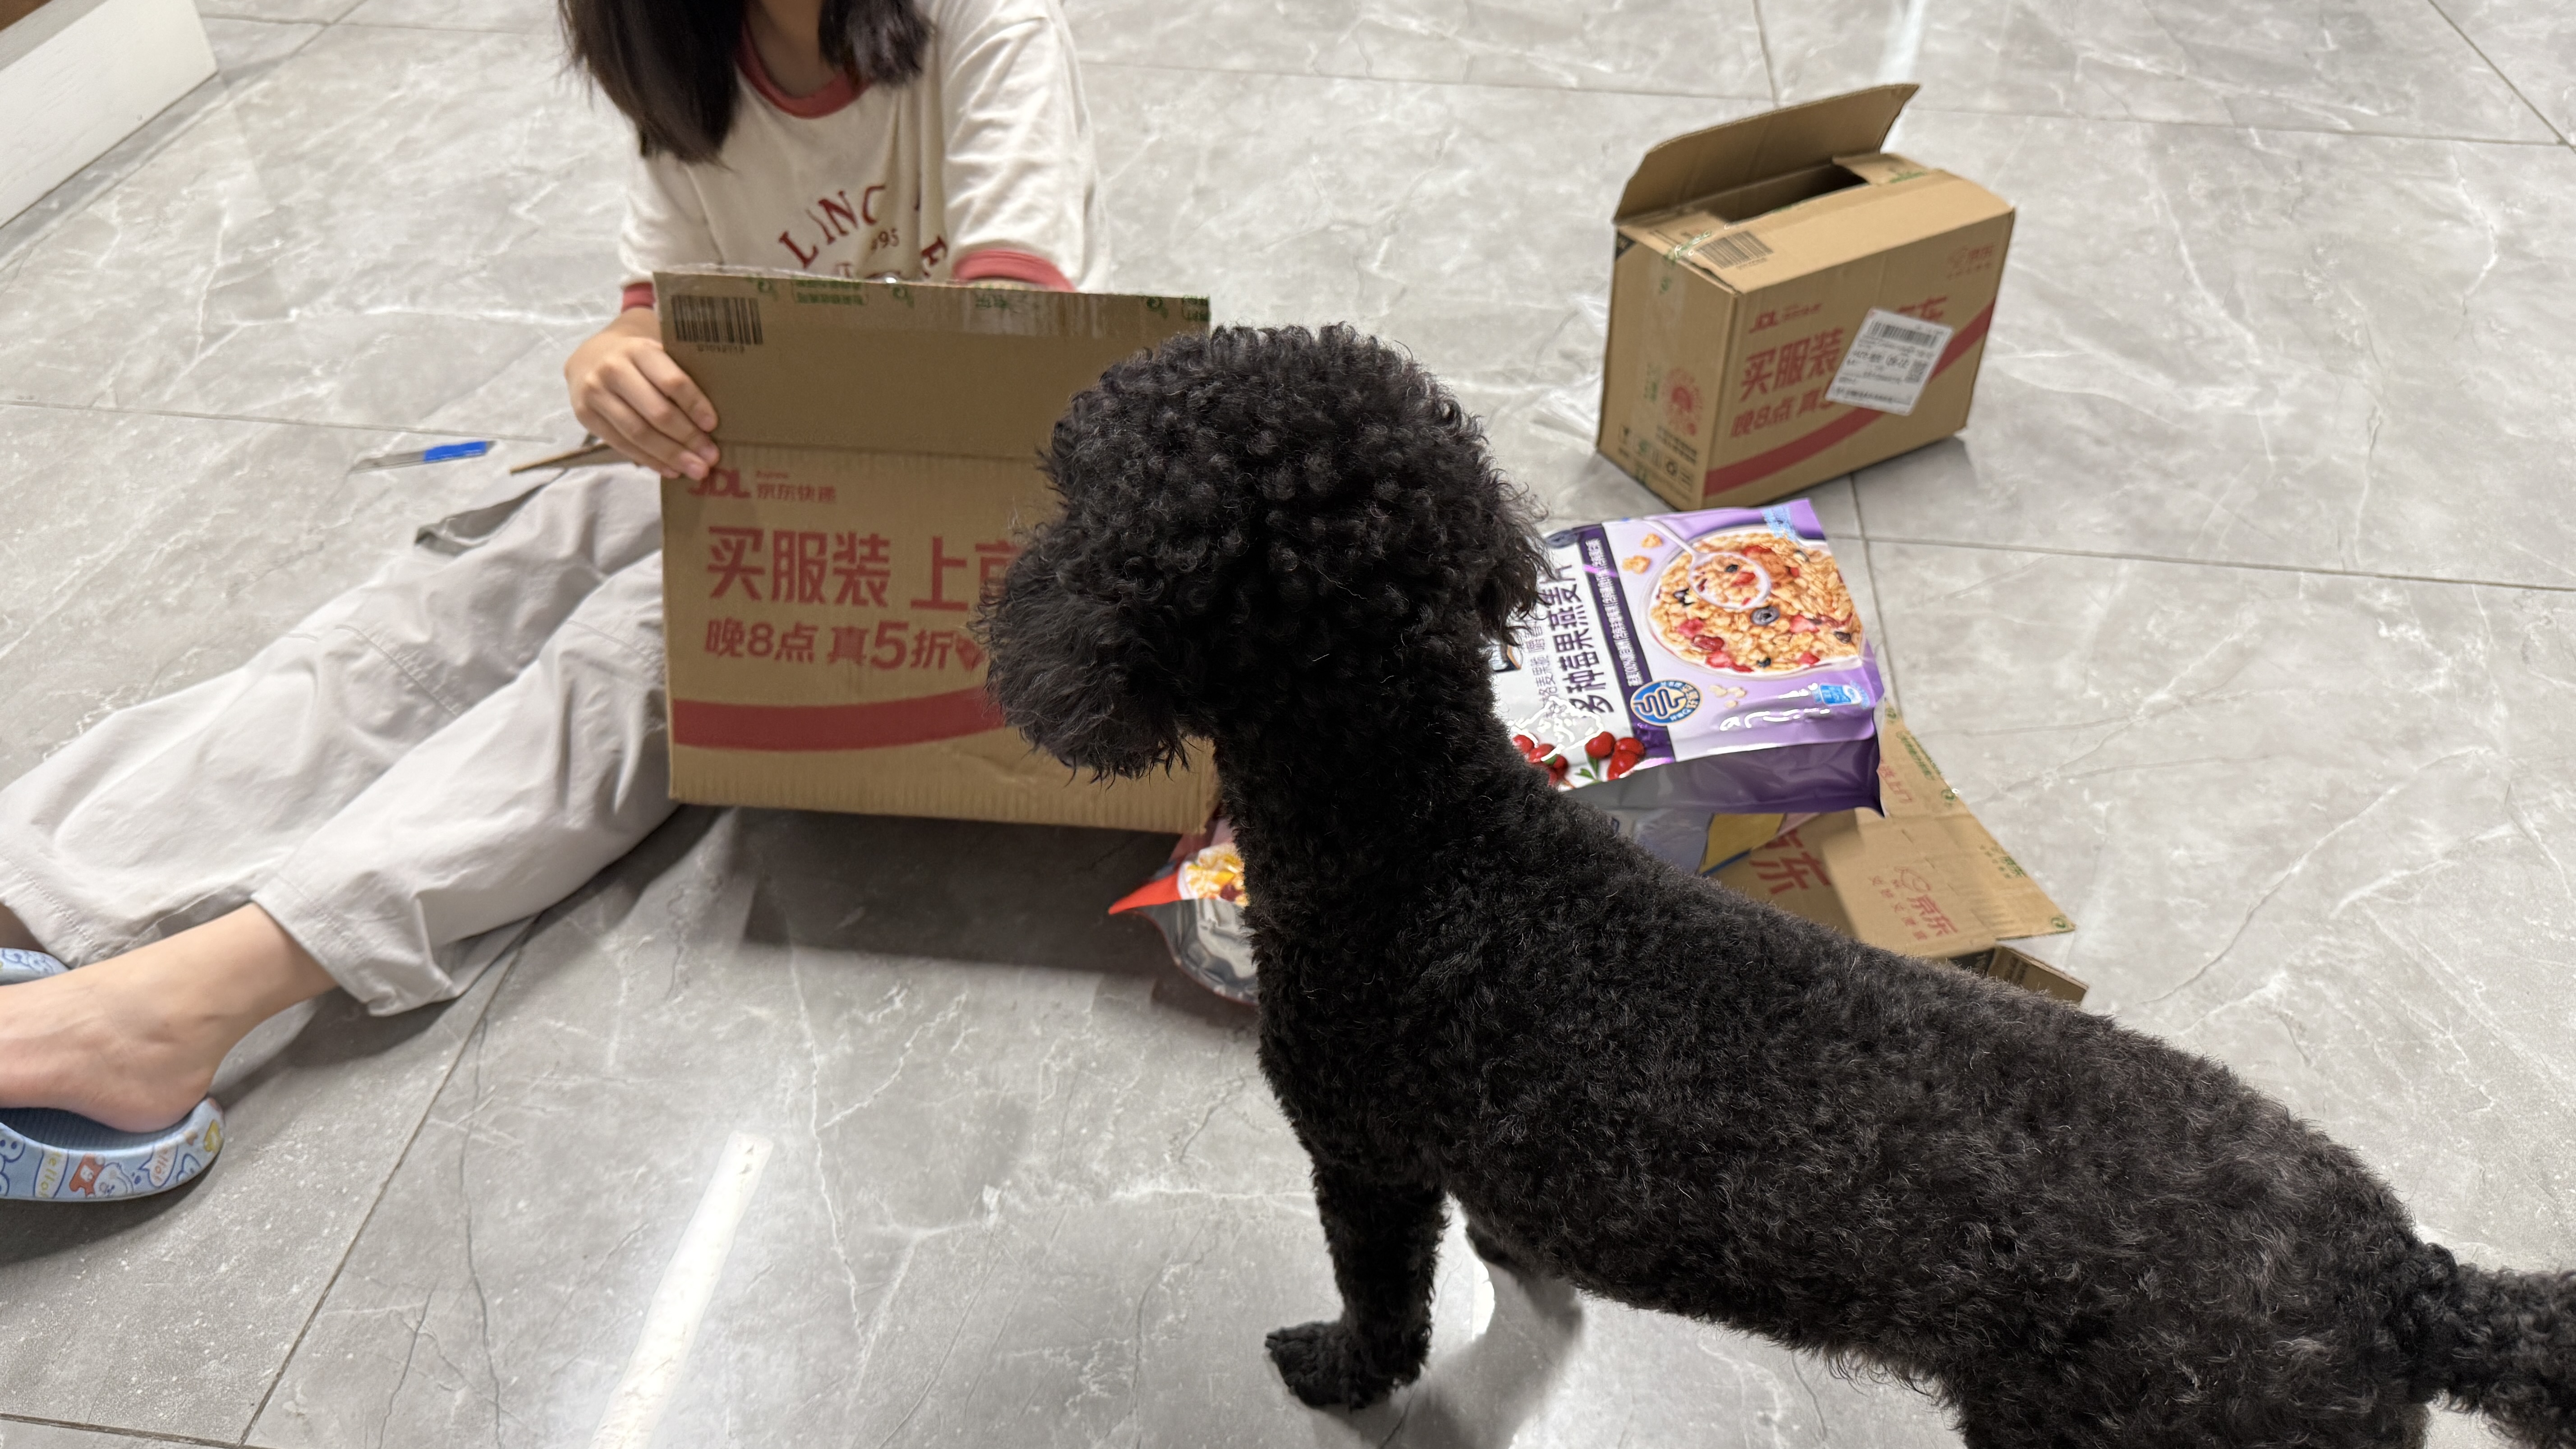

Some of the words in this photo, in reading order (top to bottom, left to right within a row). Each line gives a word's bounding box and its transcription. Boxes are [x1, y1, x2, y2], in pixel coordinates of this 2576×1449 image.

[1740, 327, 1845, 403] 买服装
[705, 525, 891, 609] 买服装
[704, 617, 819, 663] 晚8点
[826, 621, 955, 671] 真5折
[1907, 894, 1958, 937] 京东
